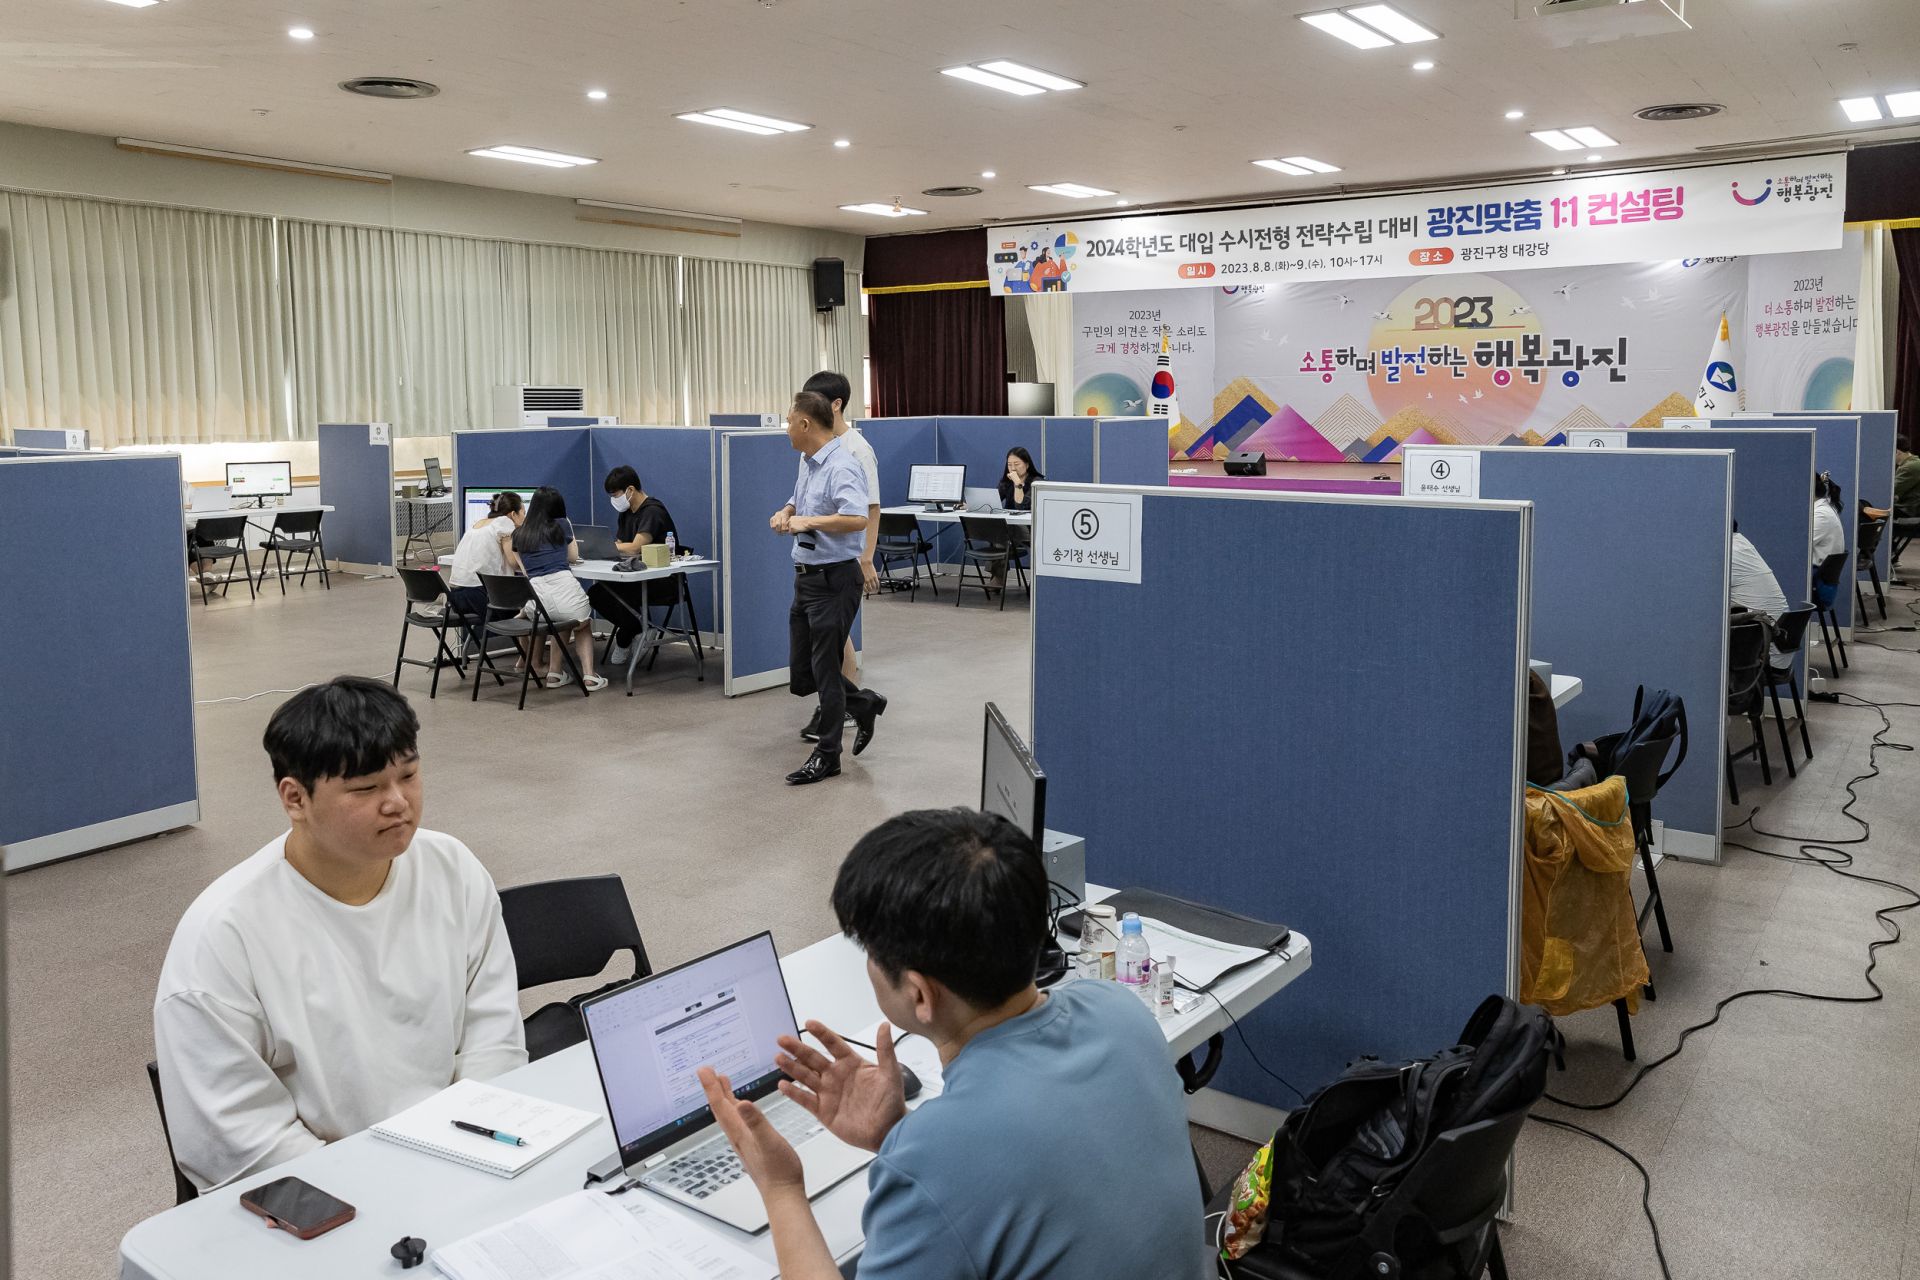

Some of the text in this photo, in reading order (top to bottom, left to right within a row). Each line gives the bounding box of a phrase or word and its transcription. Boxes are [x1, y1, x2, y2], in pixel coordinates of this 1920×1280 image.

[1777, 173, 1832, 187] 소통하며 발전하는
[1776, 183, 1833, 203] 행복광진
[1086, 186, 1684, 259] 2024학년도 대입 수시전형 전략수립 대비 광진맞춤 1:1 컨설팅
[1460, 245, 1509, 261] 광진구청
[1512, 242, 1550, 258] 대강당
[1793, 276, 1823, 292] 2023년
[1414, 296, 1493, 328] 2023
[1765, 295, 1856, 316] 더 소통하며 발전하는
[1129, 310, 1161, 322] 2023년
[1081, 326, 1113, 338] 구민의
[1117, 326, 1149, 338] 의견은
[1176, 326, 1207, 338] 소리도
[1755, 320, 1800, 338] 행복광진을
[1095, 342, 1195, 355] 크게 경청하겠니다.
[1299, 334, 1628, 388] 소통하며 발전하는 행복광진
[1441, 484, 1461, 493] 선생님
[1053, 548, 1119, 566] 송기정 선생님
